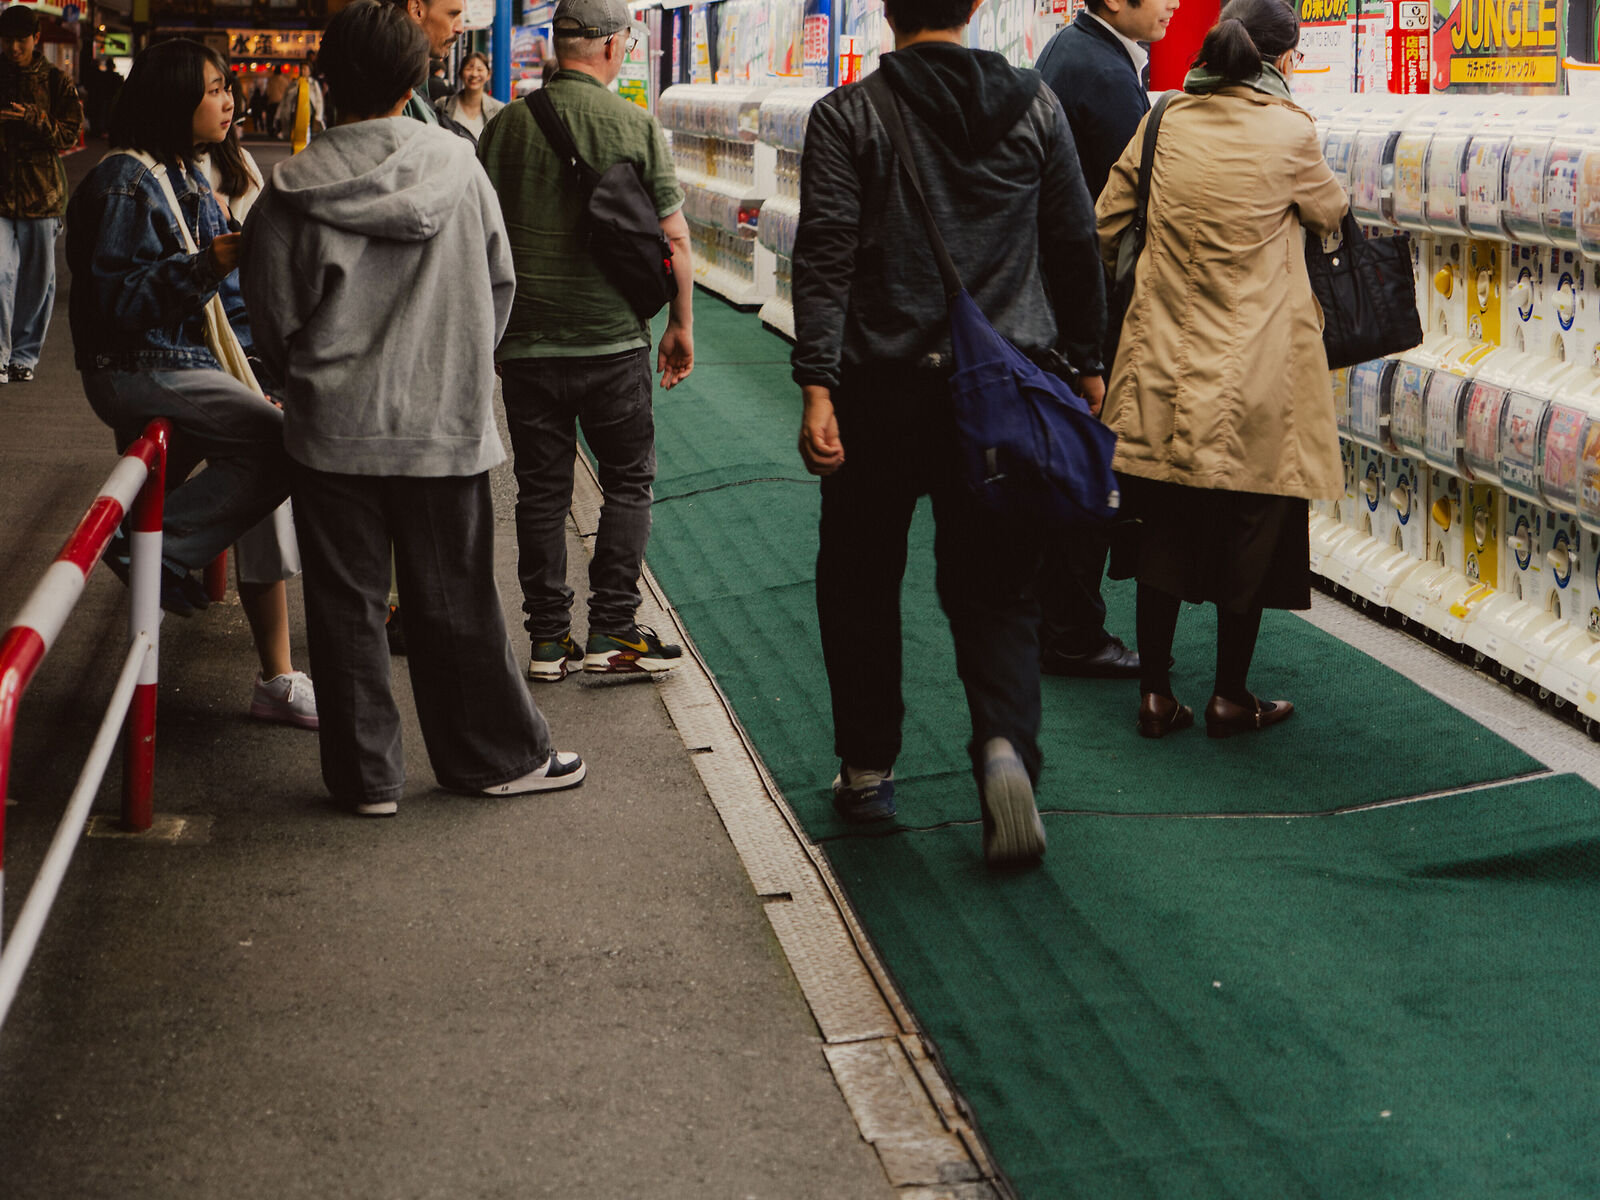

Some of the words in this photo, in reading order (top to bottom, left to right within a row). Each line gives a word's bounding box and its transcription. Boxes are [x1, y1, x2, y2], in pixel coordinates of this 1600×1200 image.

[1405, 35, 1420, 94] 店内にありま
[1466, 60, 1502, 78] ガチャガチャ
[1504, 59, 1536, 77] ジャングル
